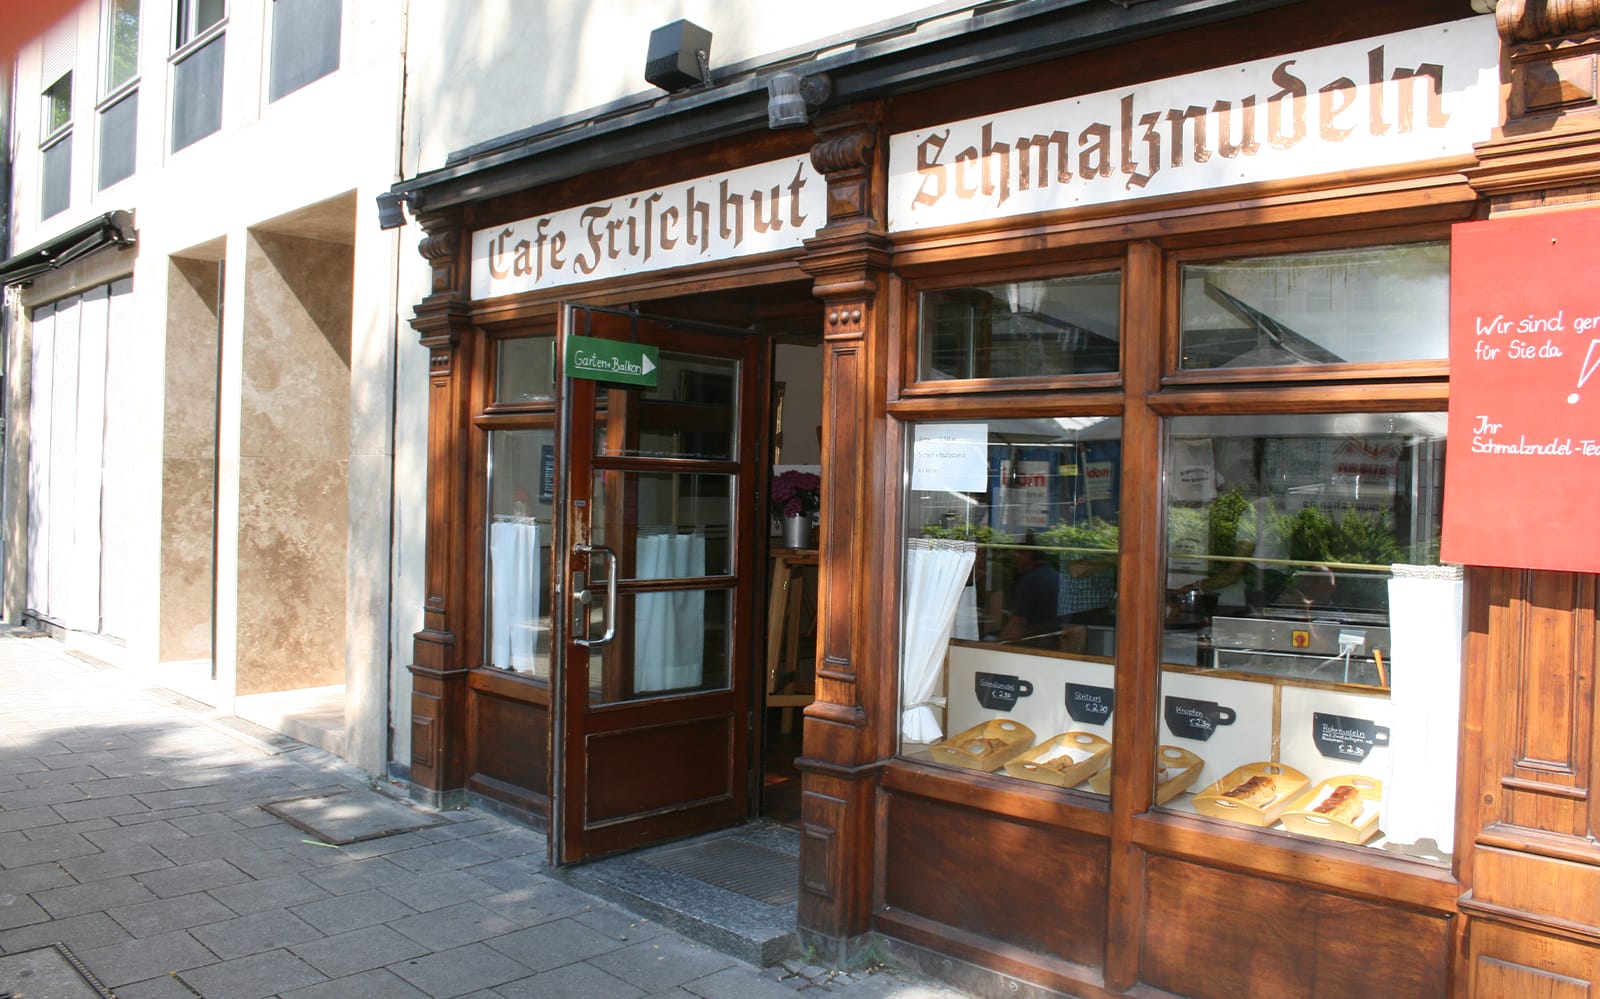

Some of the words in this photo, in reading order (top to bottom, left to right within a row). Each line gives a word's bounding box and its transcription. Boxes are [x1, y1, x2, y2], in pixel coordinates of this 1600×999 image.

[911, 44, 1452, 212] Schmalznudeln
[487, 215, 567, 285] Cafe
[1476, 314, 1514, 336] Wir
[1516, 309, 1565, 333] sind
[1474, 339, 1500, 361] für
